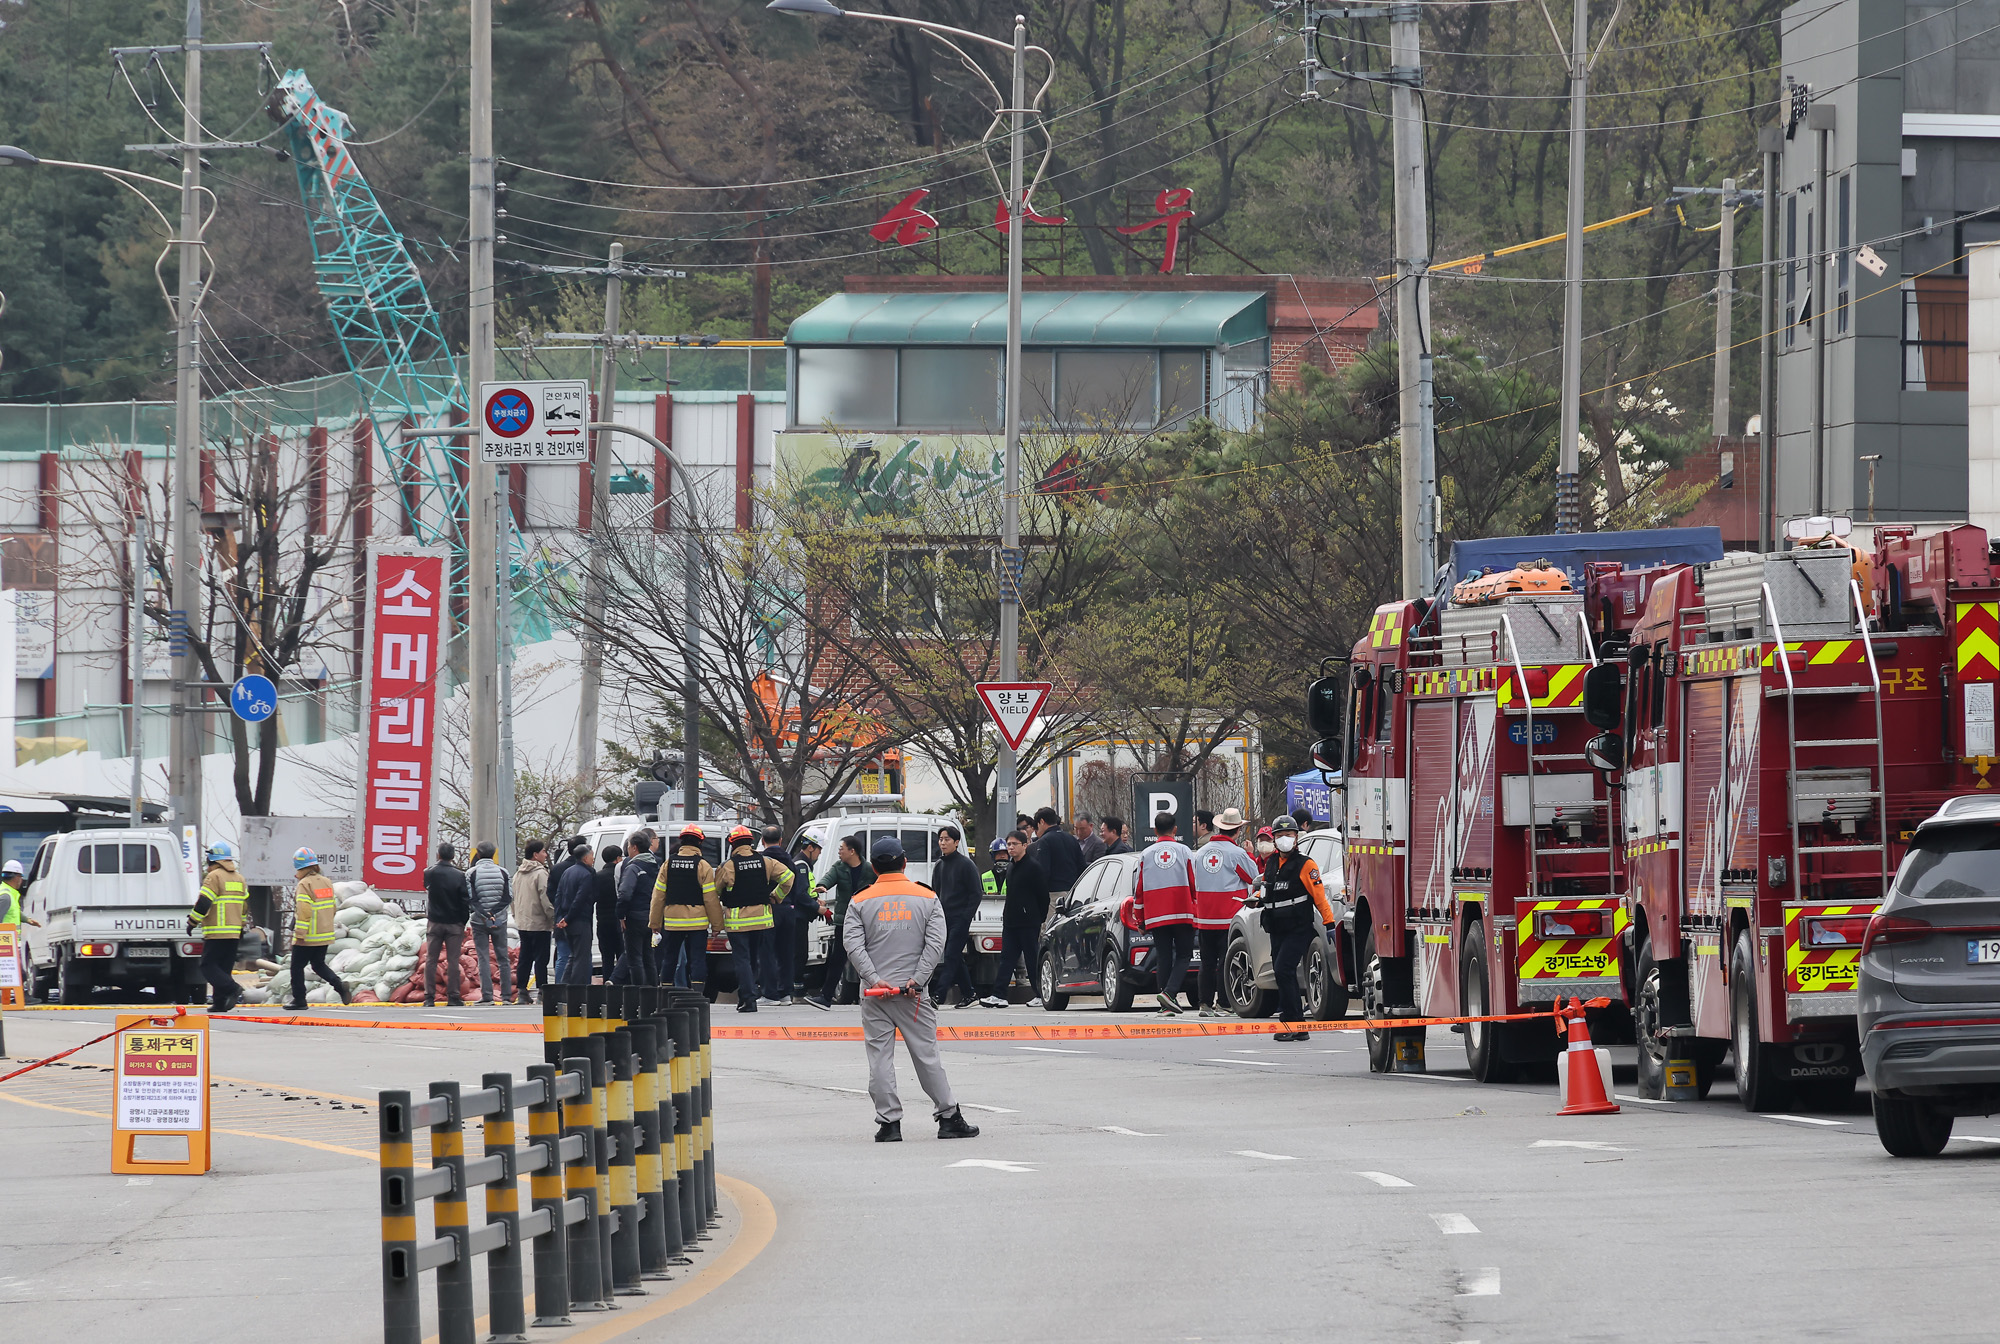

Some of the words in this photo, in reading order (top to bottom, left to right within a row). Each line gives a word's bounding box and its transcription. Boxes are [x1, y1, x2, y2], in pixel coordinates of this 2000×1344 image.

[545, 392, 580, 401] 견인지역
[493, 408, 526, 417] 주정차금지
[484, 442, 531, 457] 주정차금지
[535, 442, 544, 456] 및
[547, 440, 585, 456] 견인지역
[1881, 667, 1928, 694] 구조
[999, 706, 1029, 714] YIELD
[371, 568, 432, 875] 소머리곰탕
[1149, 792, 1178, 829] P
[883, 901, 907, 911] 경기도
[115, 919, 181, 929] HYUNDAI
[1545, 955, 1608, 970] 경기도소방
[130, 1037, 193, 1052] 통제구역
[129, 1061, 145, 1069] 허가자
[146, 1061, 152, 1069] 외
[171, 1061, 192, 1069] 출입금지
[1791, 1066, 1849, 1077] DAEWOO
